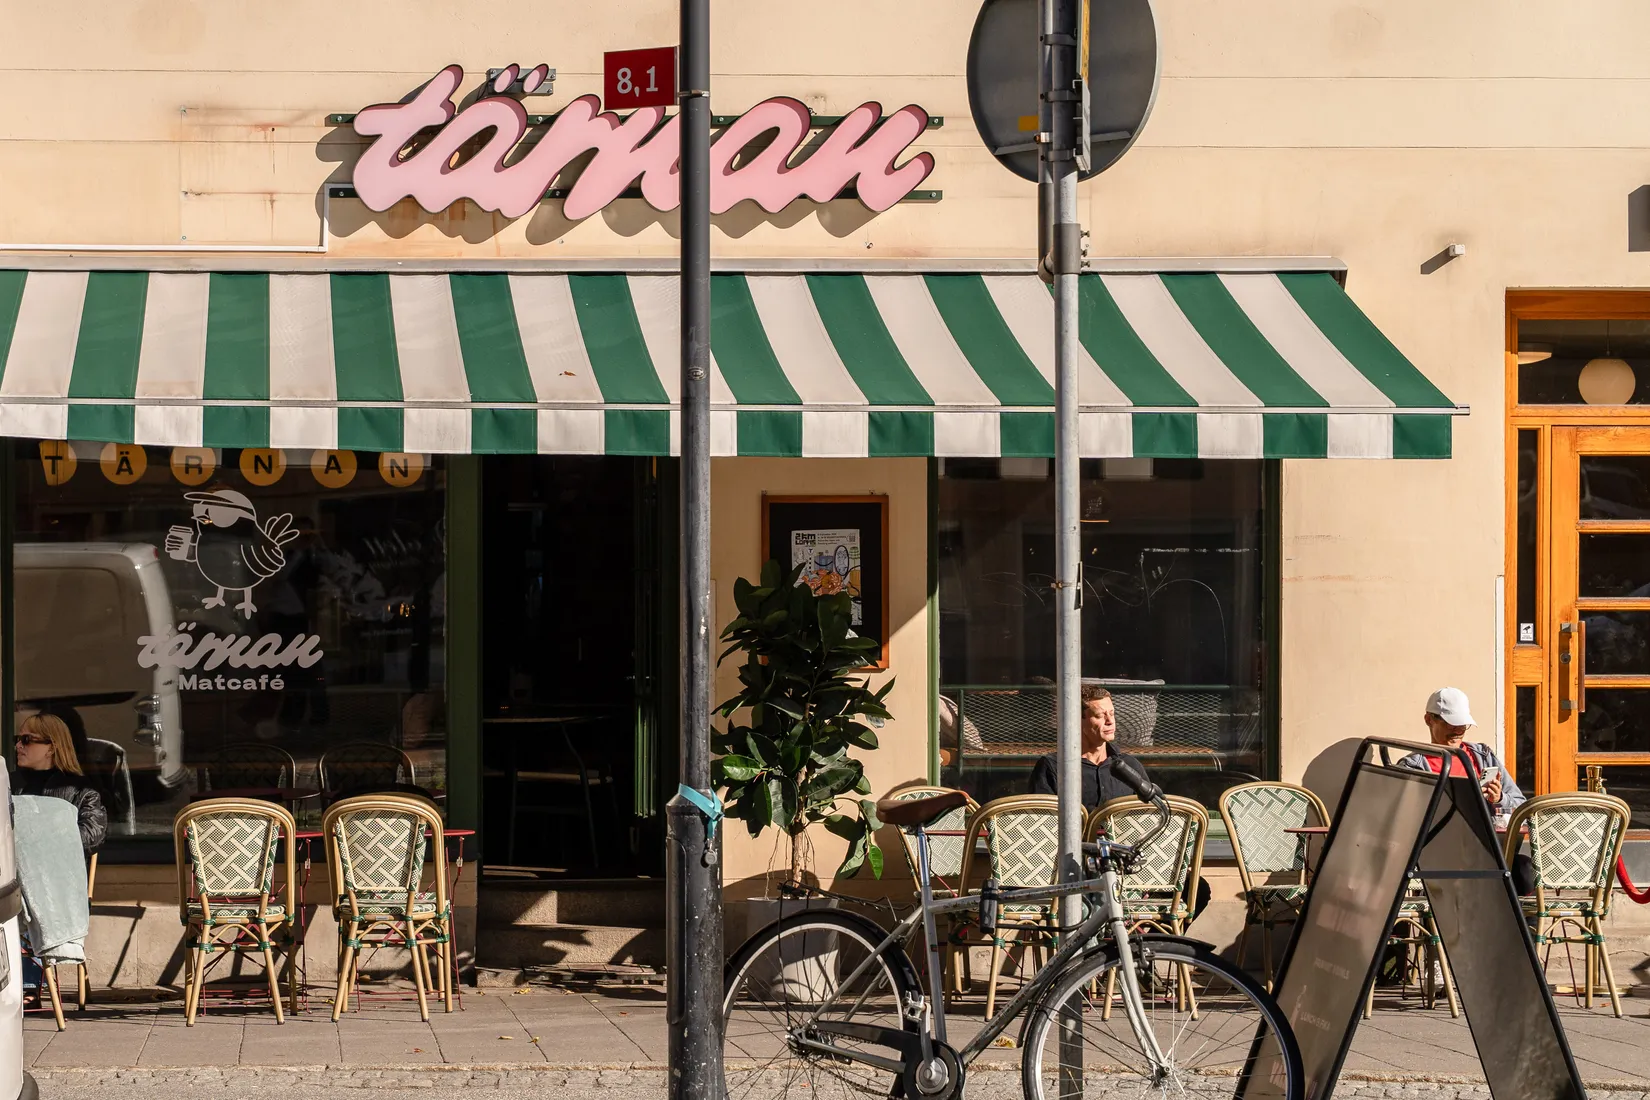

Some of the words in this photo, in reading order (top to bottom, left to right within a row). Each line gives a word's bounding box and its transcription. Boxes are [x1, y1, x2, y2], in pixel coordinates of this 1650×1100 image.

[616, 65, 659, 97] 8,1
[44, 450, 409, 478] TÄRNAN
[178, 674, 285, 691] Matcafé
